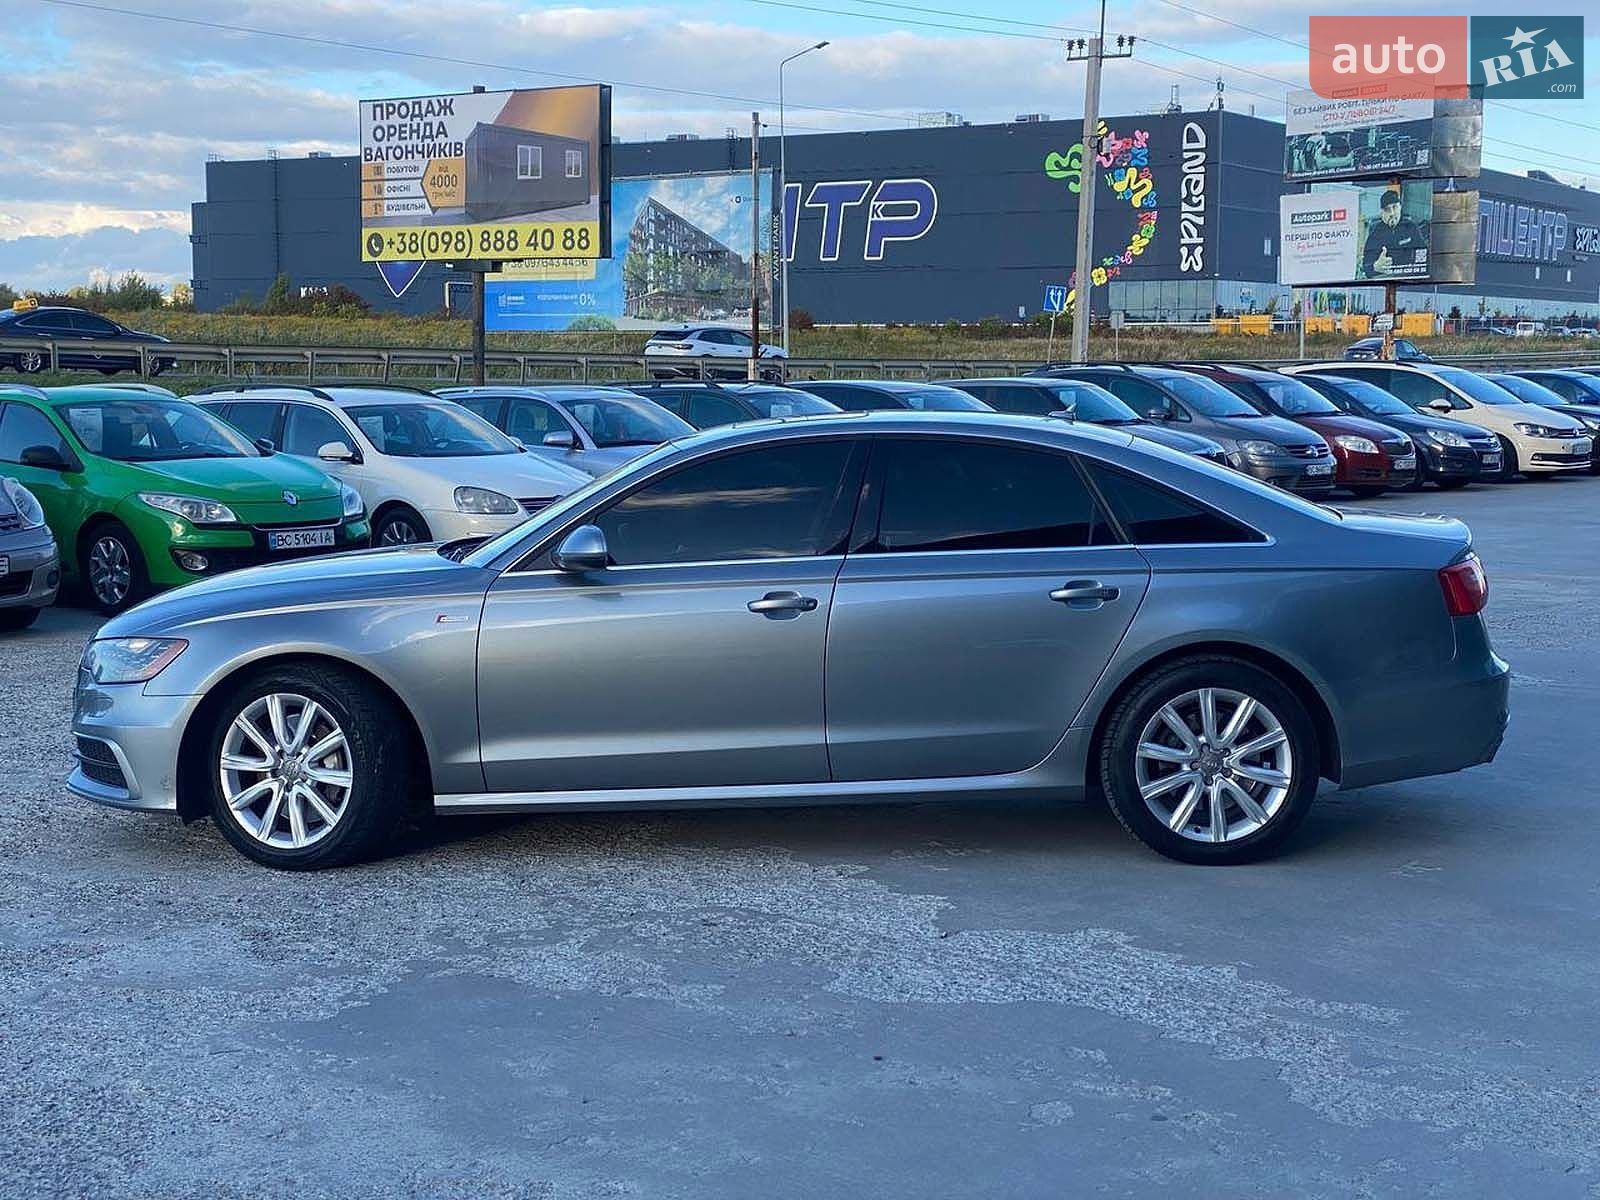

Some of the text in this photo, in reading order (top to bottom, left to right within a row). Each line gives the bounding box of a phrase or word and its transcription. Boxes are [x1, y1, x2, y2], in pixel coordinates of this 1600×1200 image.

[372, 98, 455, 122] ПРОДАЖ
[373, 122, 449, 143] ОРЕНДА
[364, 142, 464, 162] ВАГОНЧИКІВ
[430, 174, 458, 188] 4000
[387, 227, 590, 257] +38(098) 888 40 88
[277, 533, 292, 546] BC
[294, 532, 317, 545] 5104
